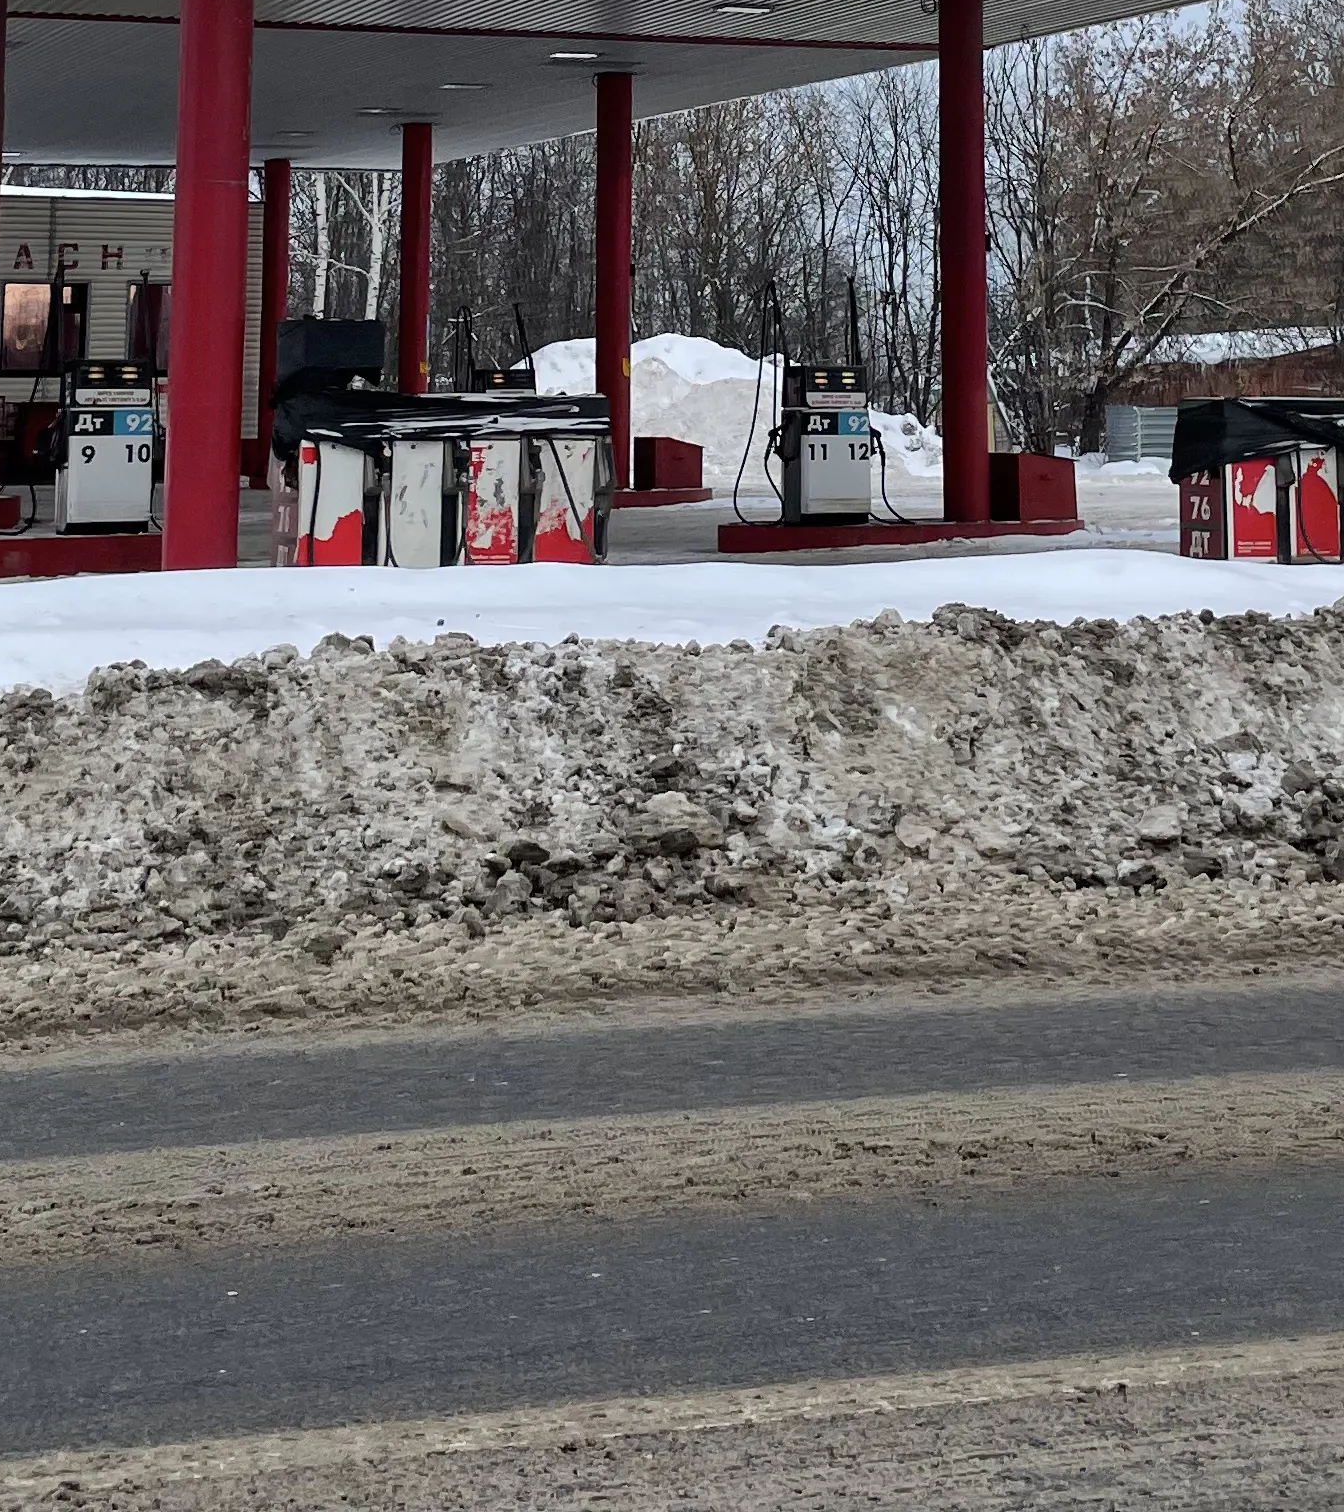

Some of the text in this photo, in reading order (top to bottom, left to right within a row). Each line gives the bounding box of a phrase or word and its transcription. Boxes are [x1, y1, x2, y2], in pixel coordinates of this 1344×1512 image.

[126, 413, 153, 432] 92
[848, 415, 870, 432] 92
[81, 443, 151, 464] 9 10
[808, 442, 870, 461] 11 12
[1189, 495, 1211, 521] 76
[1189, 531, 1211, 557] ДТ
